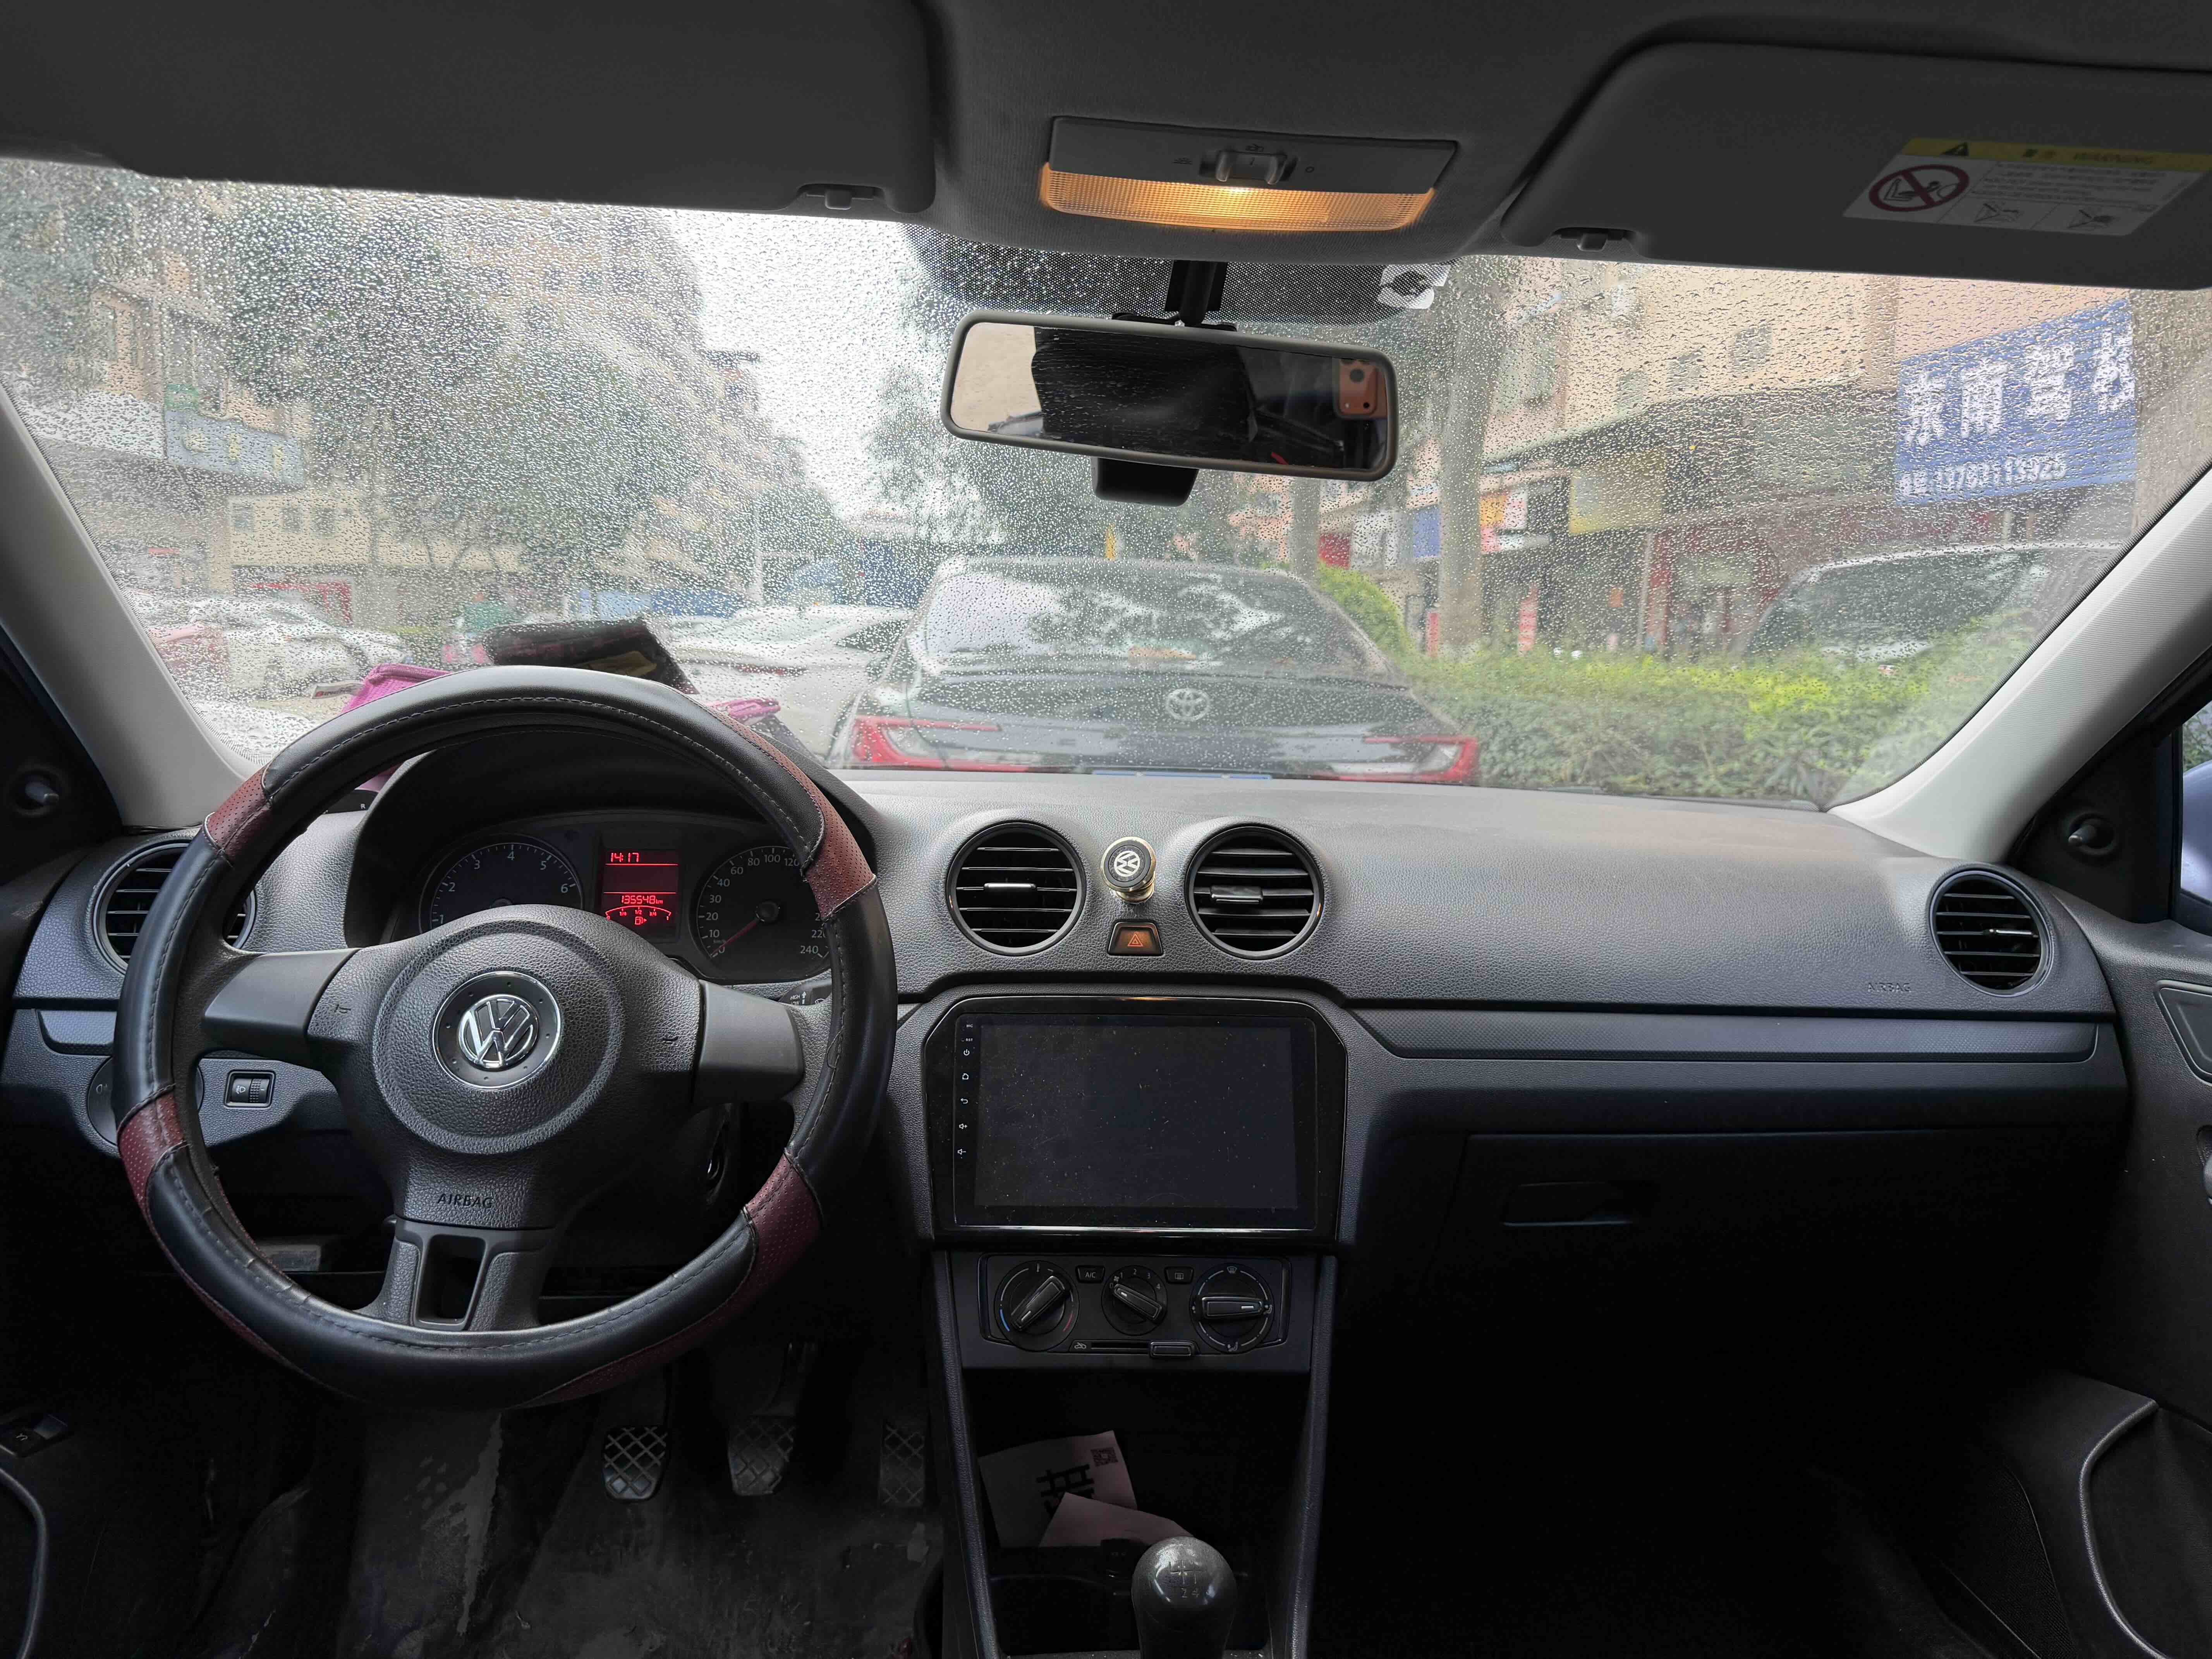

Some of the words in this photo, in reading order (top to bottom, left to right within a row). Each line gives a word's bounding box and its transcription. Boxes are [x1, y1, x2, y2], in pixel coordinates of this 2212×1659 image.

[507, 851, 515, 860] 4
[610, 852, 639, 862] 14:17
[764, 854, 781, 863] 100
[474, 859, 481, 870] 3
[540, 860, 547, 870] 5
[747, 858, 760, 867] 80
[784, 858, 800, 867] 120
[730, 866, 744, 875] 60
[448, 882, 456, 892] 2
[716, 878, 730, 887] 40
[560, 883, 568, 893] 6
[709, 895, 722, 903] 30
[440, 914, 444, 924] 1
[706, 912, 719, 921] 20
[709, 929, 720, 938] 10
[800, 945, 819, 954] 240
[1868, 982, 1910, 992] AIRBAG
[437, 1193, 494, 1208] AIRBAG
